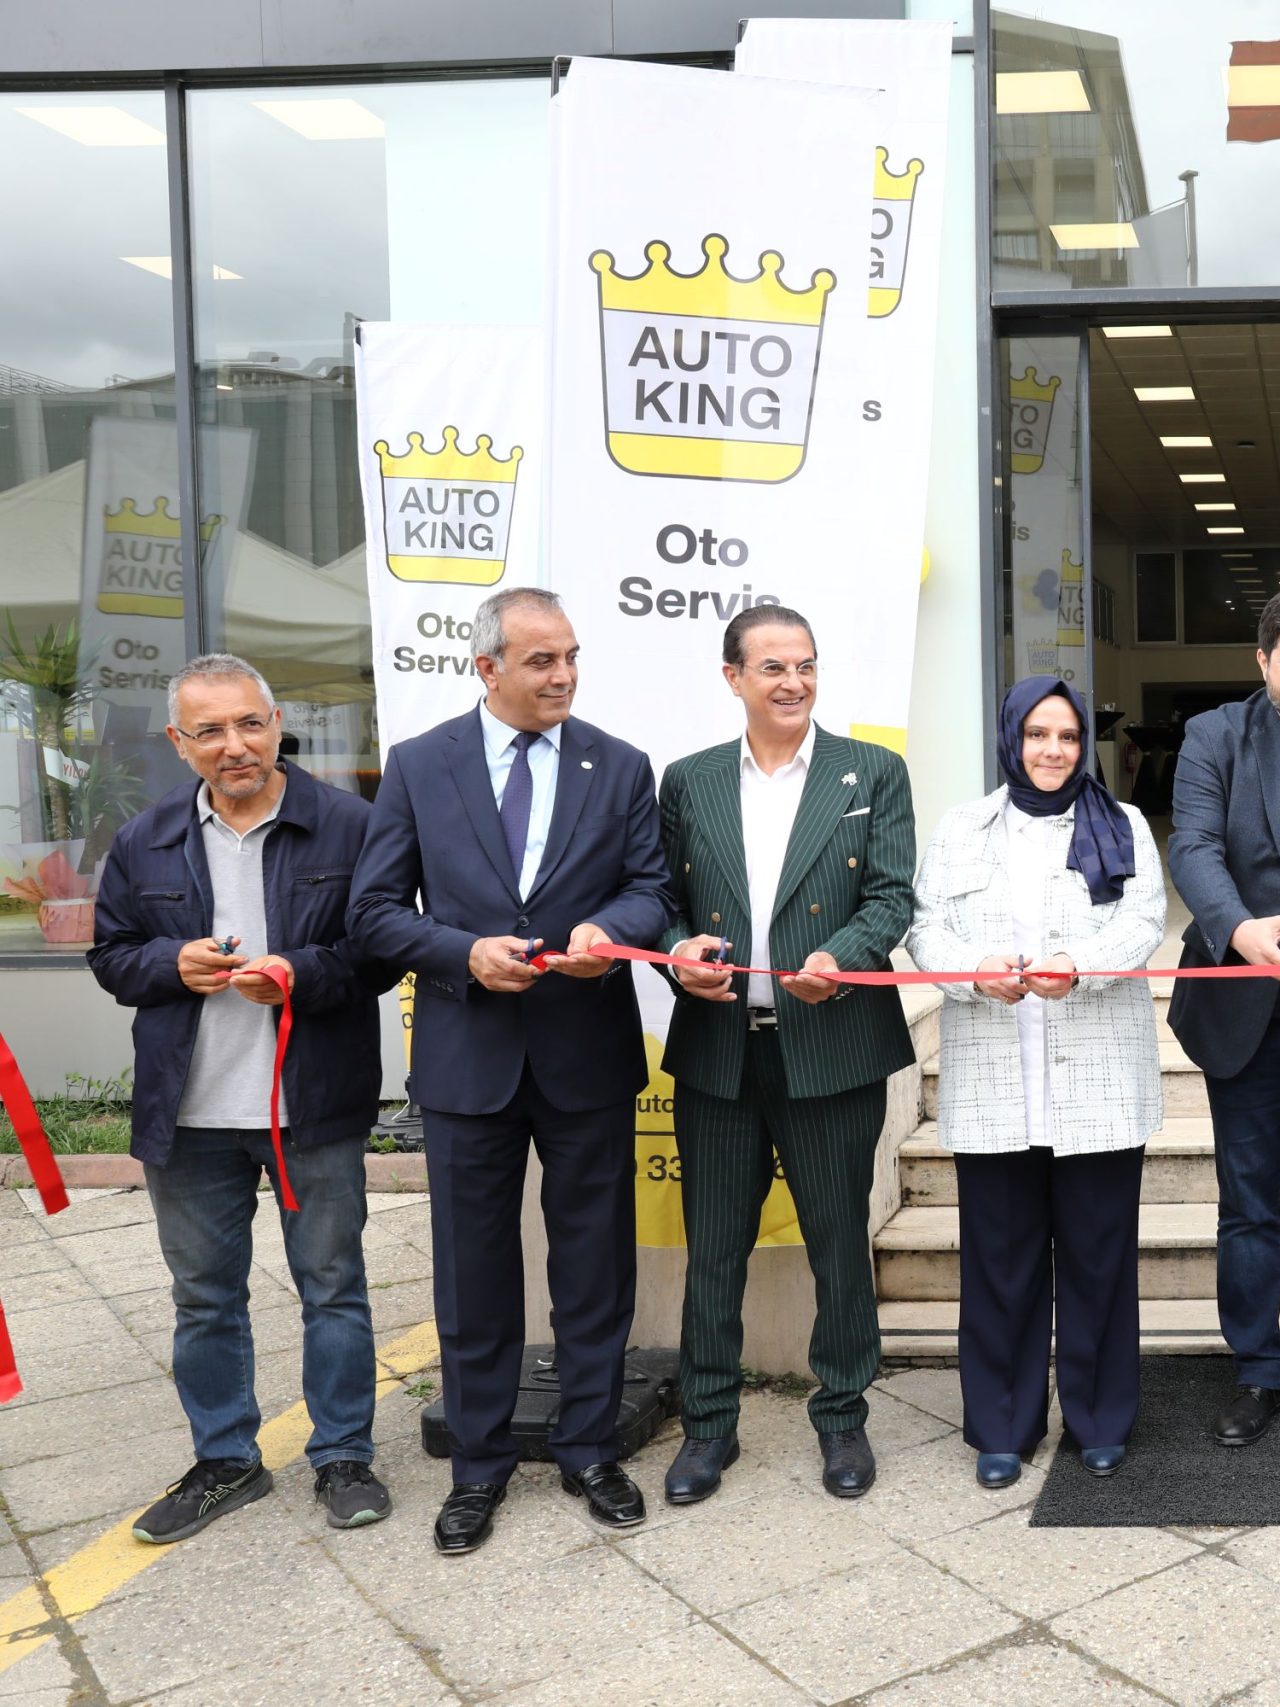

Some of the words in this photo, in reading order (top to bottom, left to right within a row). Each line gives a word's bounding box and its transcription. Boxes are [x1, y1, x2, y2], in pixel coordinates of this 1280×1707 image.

[628, 326, 792, 378] AUTO
[635, 379, 781, 430] KING
[399, 487, 500, 517] AUTO
[404, 520, 494, 551] KING
[656, 524, 749, 568] Oto
[106, 565, 183, 592] KING
[417, 612, 473, 641] Oto
[114, 638, 160, 660] Oto
[647, 1155, 682, 1182] 33
